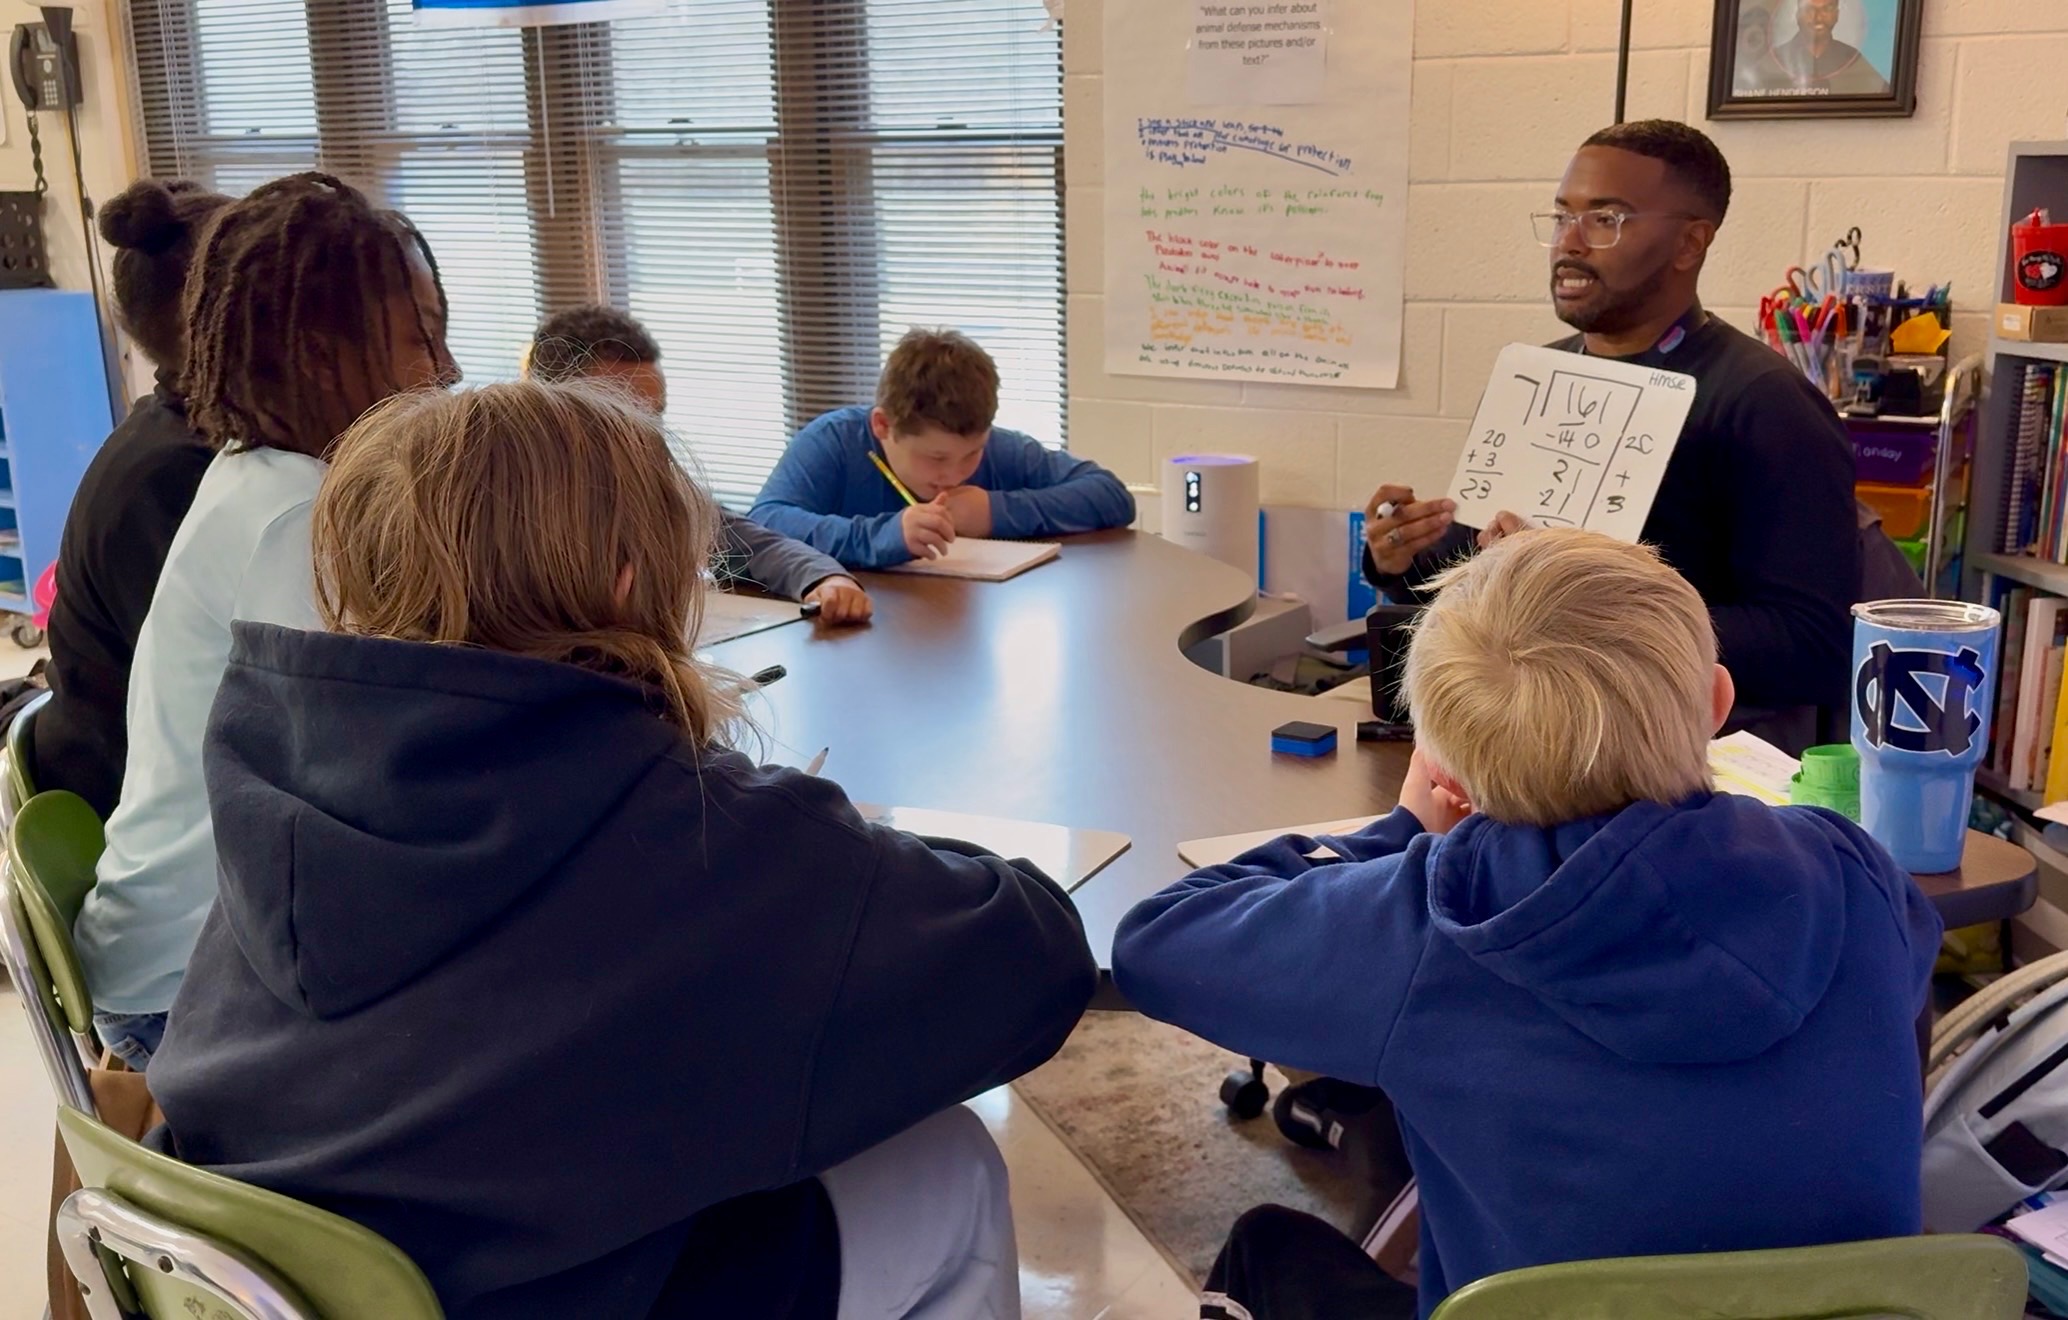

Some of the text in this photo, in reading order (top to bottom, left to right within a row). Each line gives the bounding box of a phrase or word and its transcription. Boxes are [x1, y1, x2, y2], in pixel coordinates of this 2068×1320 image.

[1229, 7, 1246, 16] can
[1248, 6, 1265, 16] you
[1267, 4, 1288, 14] infer
[1290, 3, 1317, 14] about
[1196, 20, 1321, 34] animal defense mechanisms
[1198, 37, 1316, 50] from these pictures and/or
[1145, 230, 1162, 242] The
[1514, 374, 1541, 426] 7
[1566, 381, 1613, 425] 161
[1482, 429, 1506, 448] 20
[1484, 452, 1498, 467] 3
[1552, 459, 1583, 495] 21
[1459, 478, 1492, 500] 23
